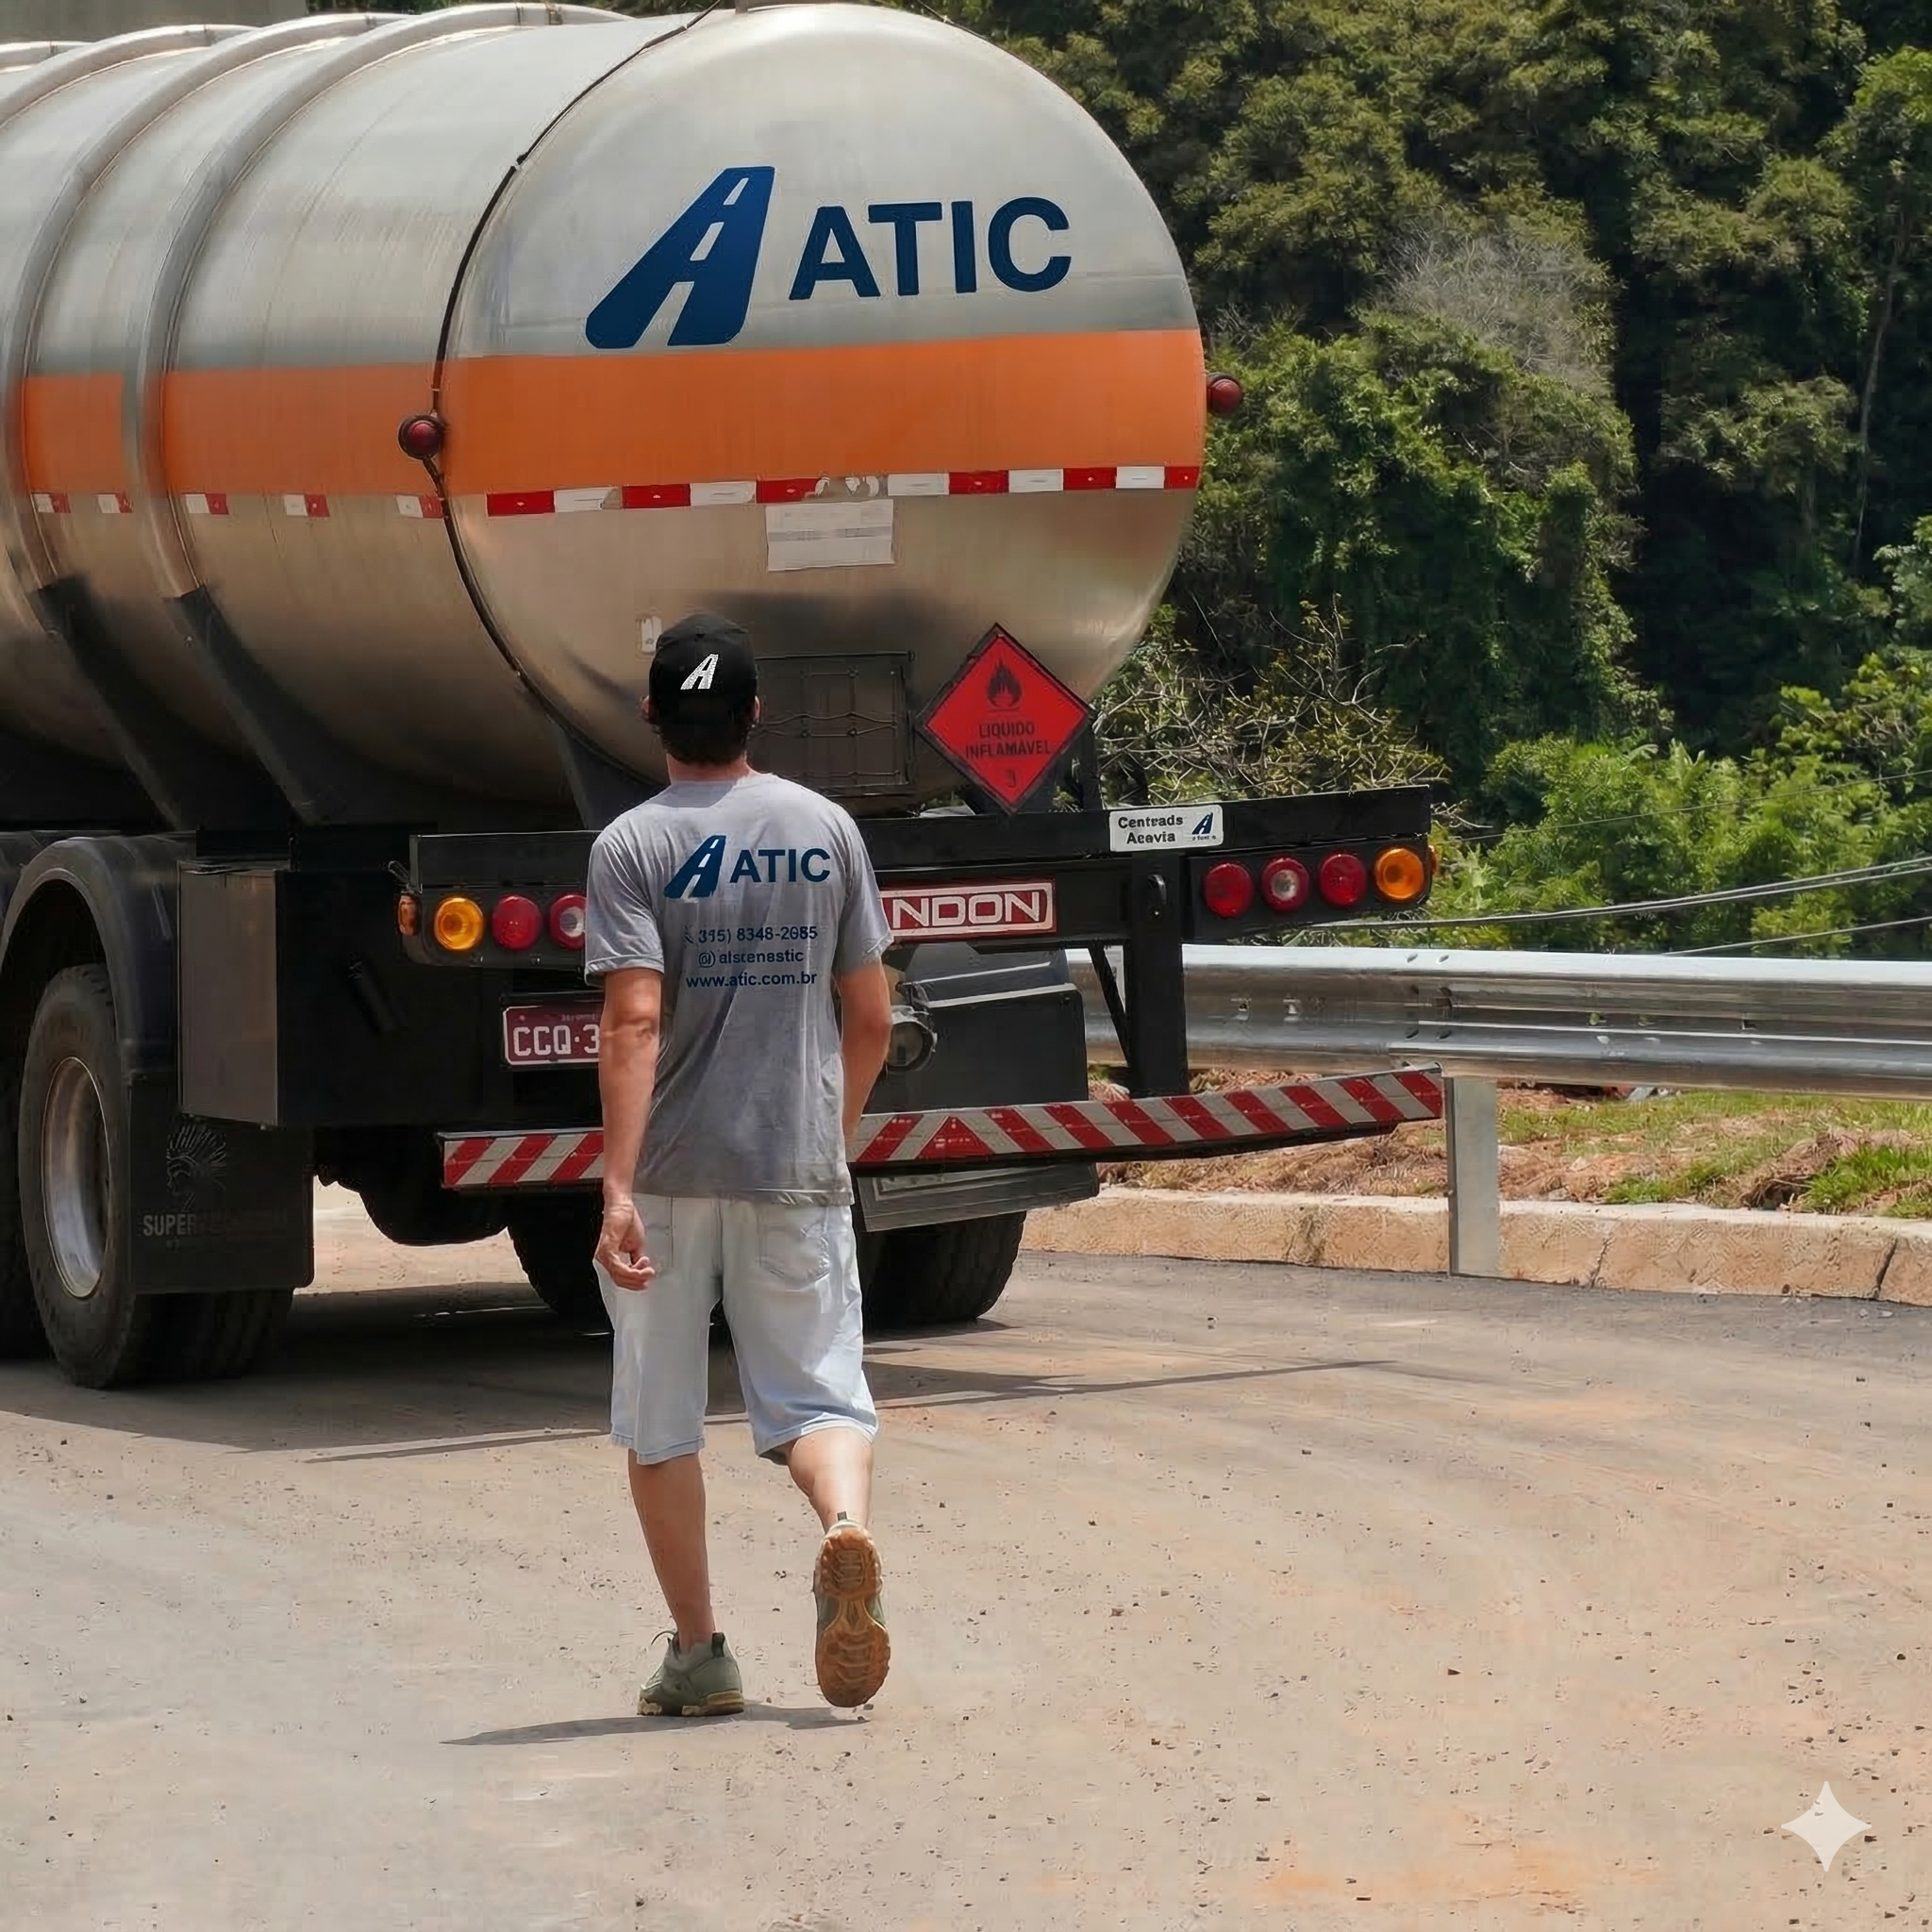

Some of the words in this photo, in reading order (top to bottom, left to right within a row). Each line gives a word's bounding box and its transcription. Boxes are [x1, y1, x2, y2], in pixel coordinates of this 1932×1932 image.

[789, 196, 1072, 300] ATIC
[729, 847, 831, 884] ATIC
[892, 891, 1040, 929] NDON
